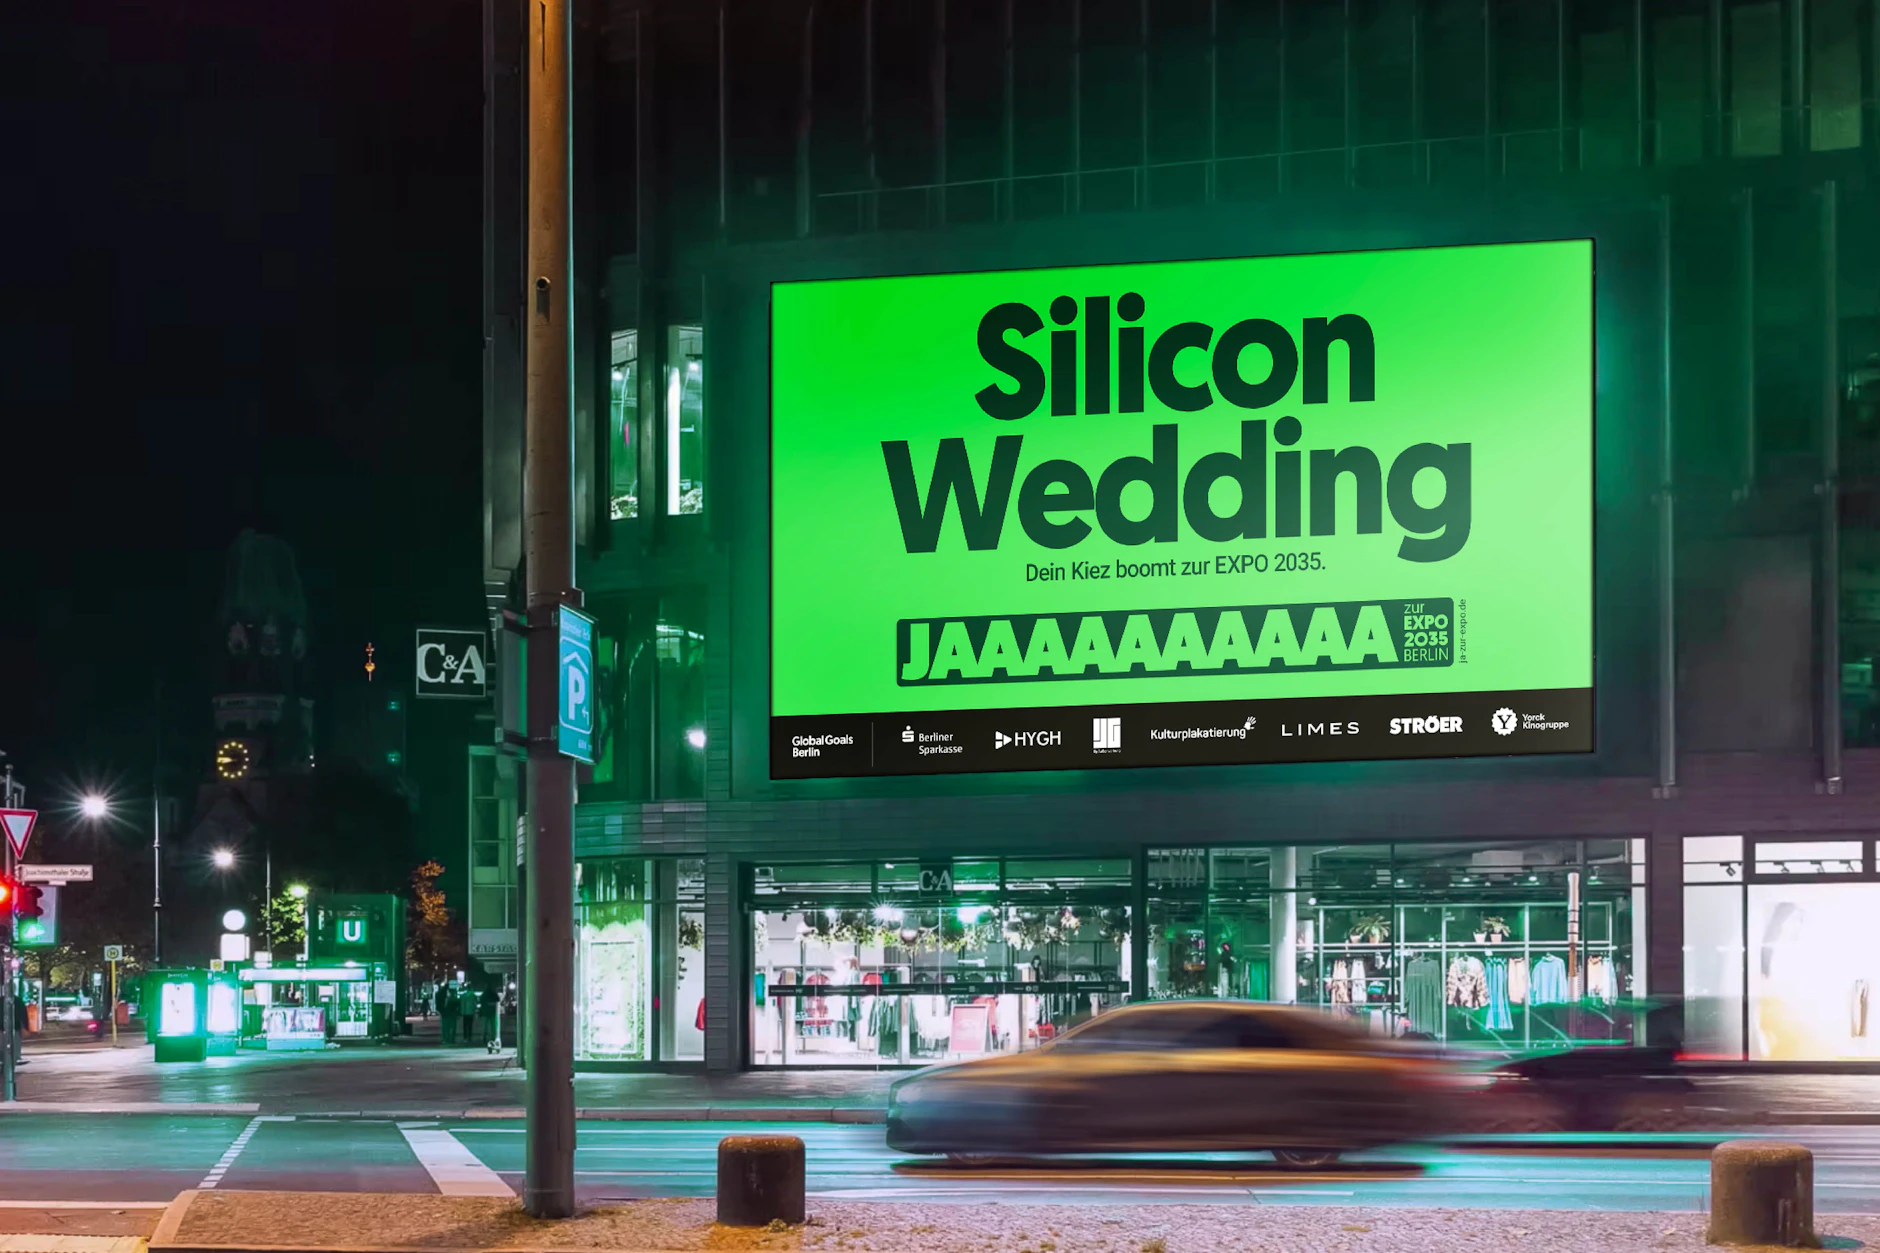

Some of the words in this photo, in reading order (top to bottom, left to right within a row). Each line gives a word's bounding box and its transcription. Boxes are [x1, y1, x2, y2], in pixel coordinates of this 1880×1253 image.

[975, 292, 1375, 420] Silicon
[881, 416, 1472, 562] Wedding
[1026, 563, 1066, 582] Dein
[1071, 561, 1111, 580] Kiez
[1116, 559, 1177, 579] boomt
[1180, 560, 1211, 576] zur
[1215, 554, 1269, 575] EXPO
[1274, 552, 1326, 572] 2035.
[1404, 603, 1425, 614] zur
[1403, 614, 1448, 630] EXPO
[1403, 630, 1449, 647] 2035
[1458, 599, 1468, 664] ja-zur-expo.de
[902, 605, 1399, 681] JAAAAAAAAAA
[1403, 647, 1449, 662] BERLIN
[416, 643, 485, 684] C&A
[568, 665, 586, 721] P
[1389, 715, 1463, 735] STRÖER
[1522, 713, 1546, 721] Yorck
[1522, 720, 1570, 730] Kinogruppe
[1150, 727, 1247, 742] Kulturplakatierung
[1281, 721, 1360, 737] LIMES
[918, 732, 954, 743] Berliner
[1014, 731, 1061, 747] HYGH
[792, 747, 821, 758] Berlin
[918, 744, 963, 756] Sparkasse
[919, 869, 952, 891] C&A
[343, 920, 361, 941] U
